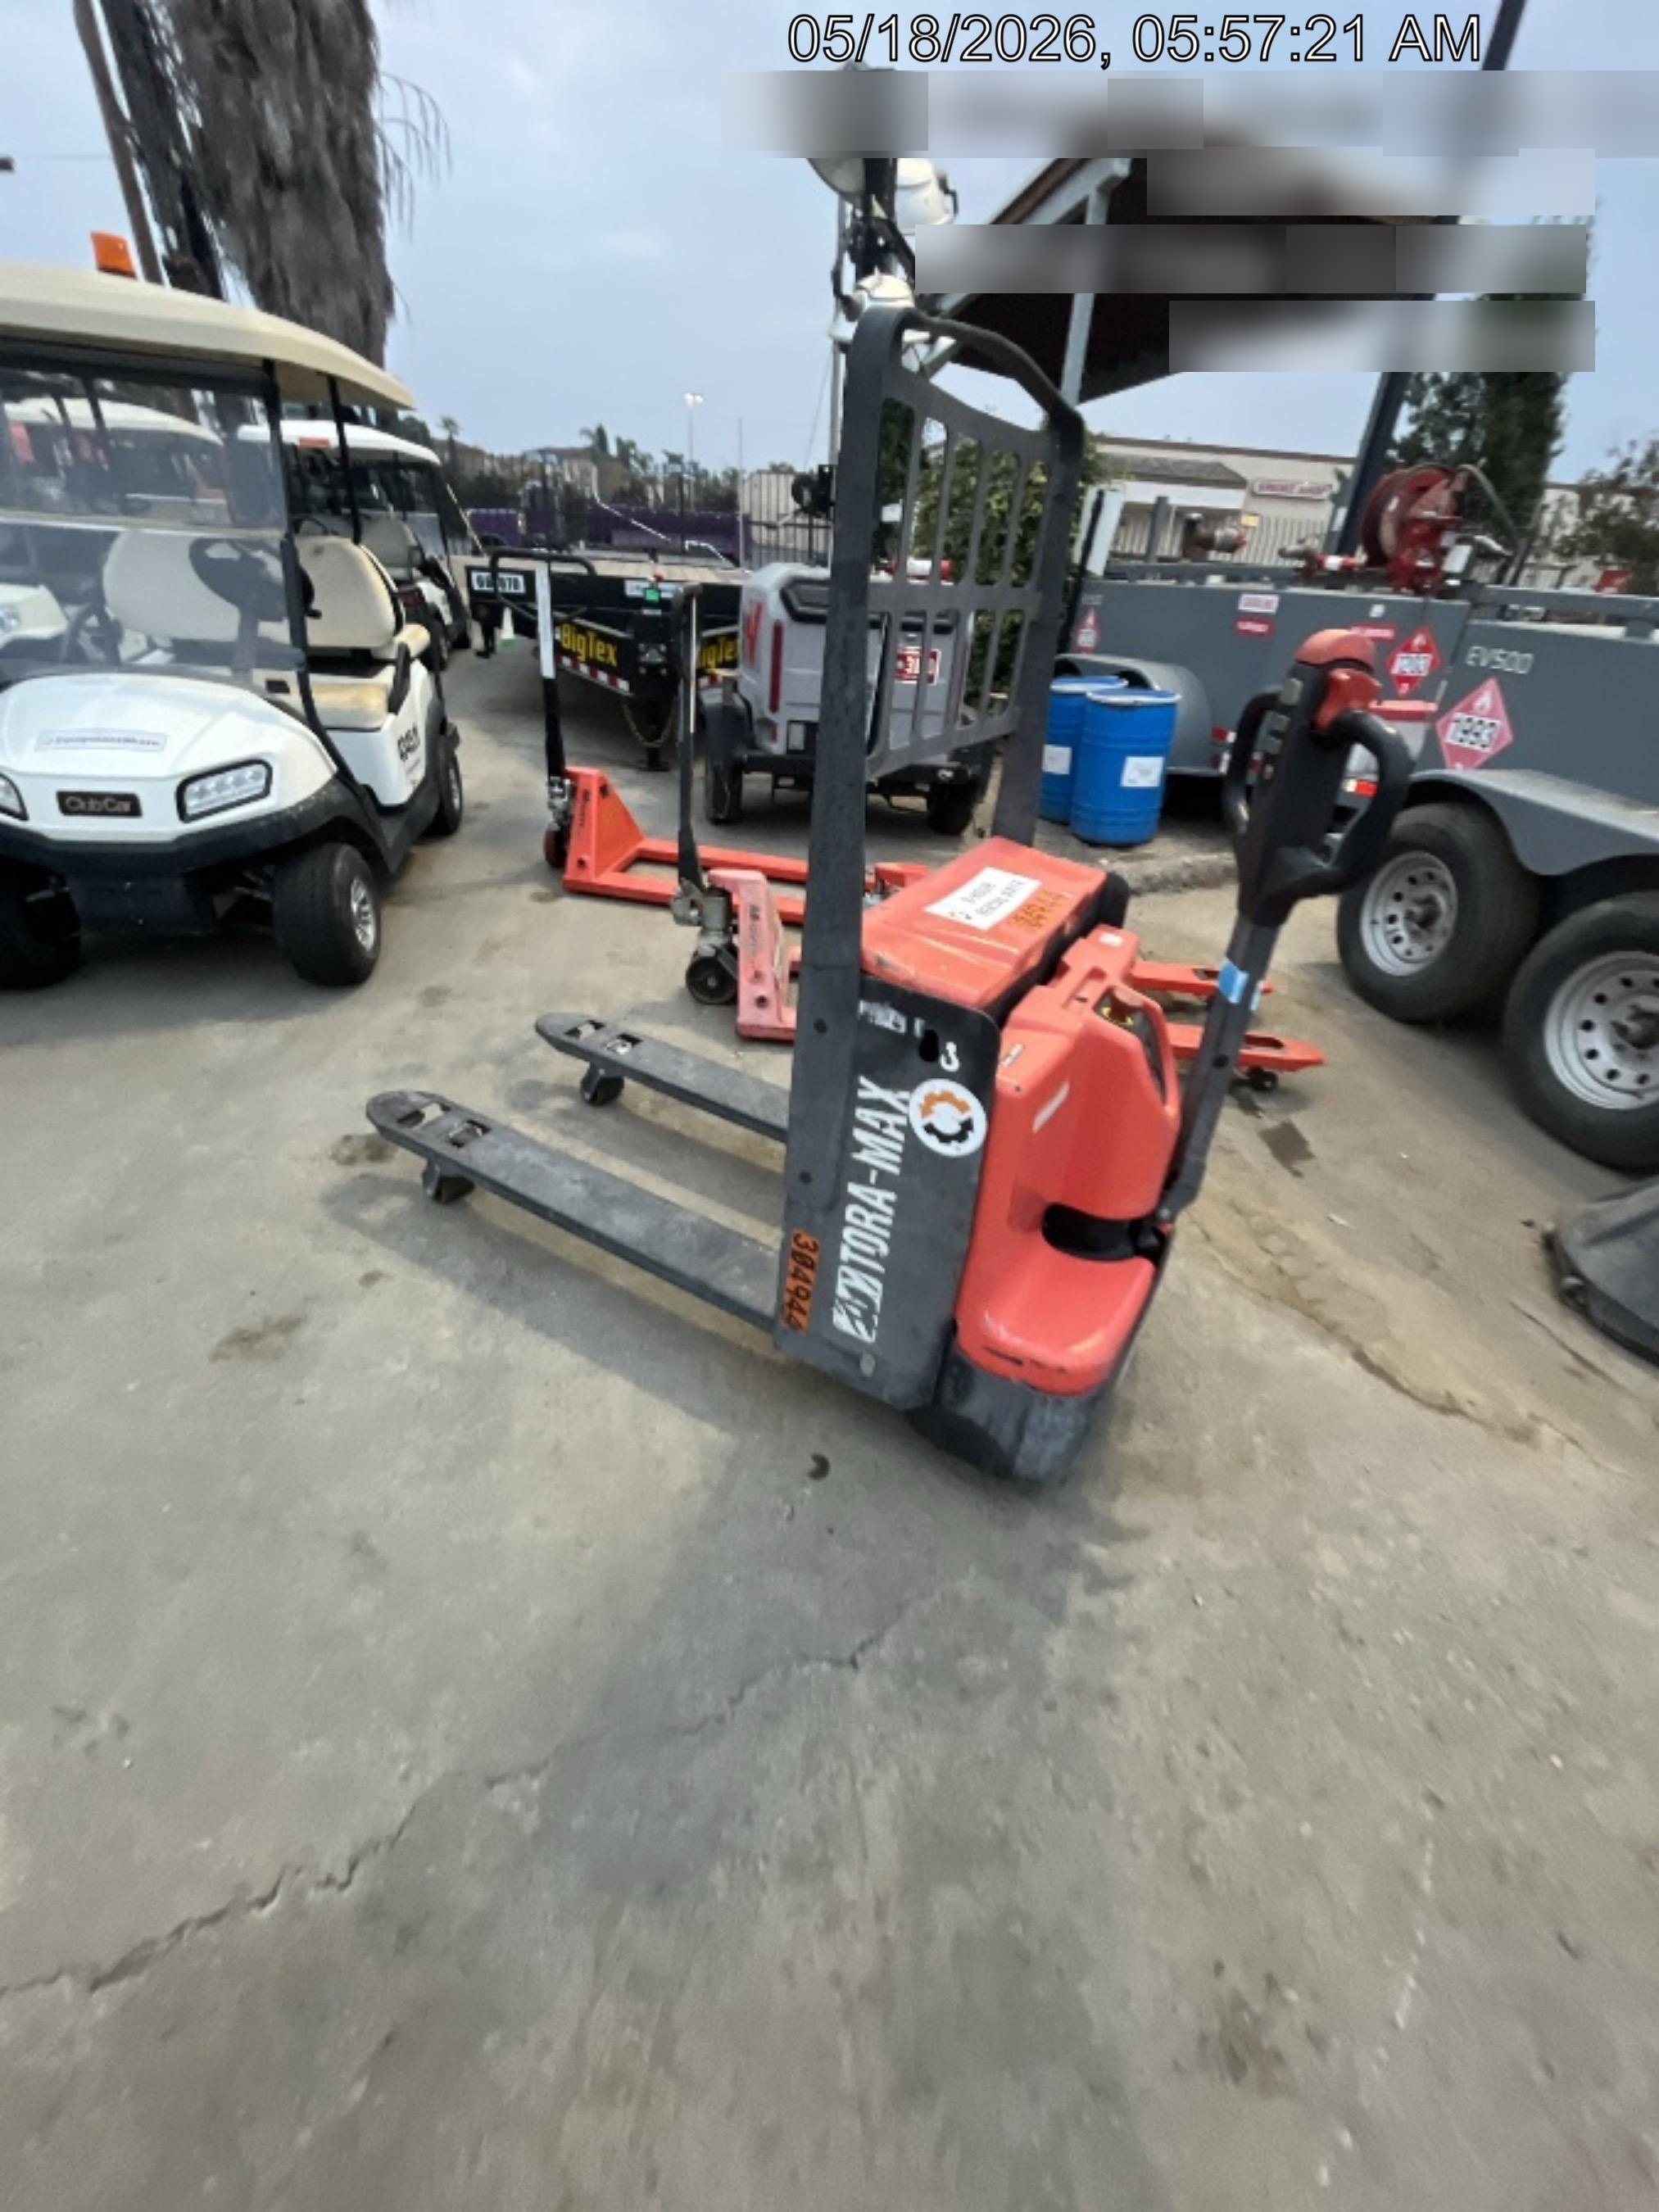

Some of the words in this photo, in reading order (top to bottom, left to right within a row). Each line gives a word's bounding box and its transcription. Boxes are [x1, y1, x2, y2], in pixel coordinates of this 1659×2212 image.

[561, 623, 618, 668] BigTex
[1466, 645, 1534, 675] EV500
[839, 1074, 911, 1275] TORA-MAX
